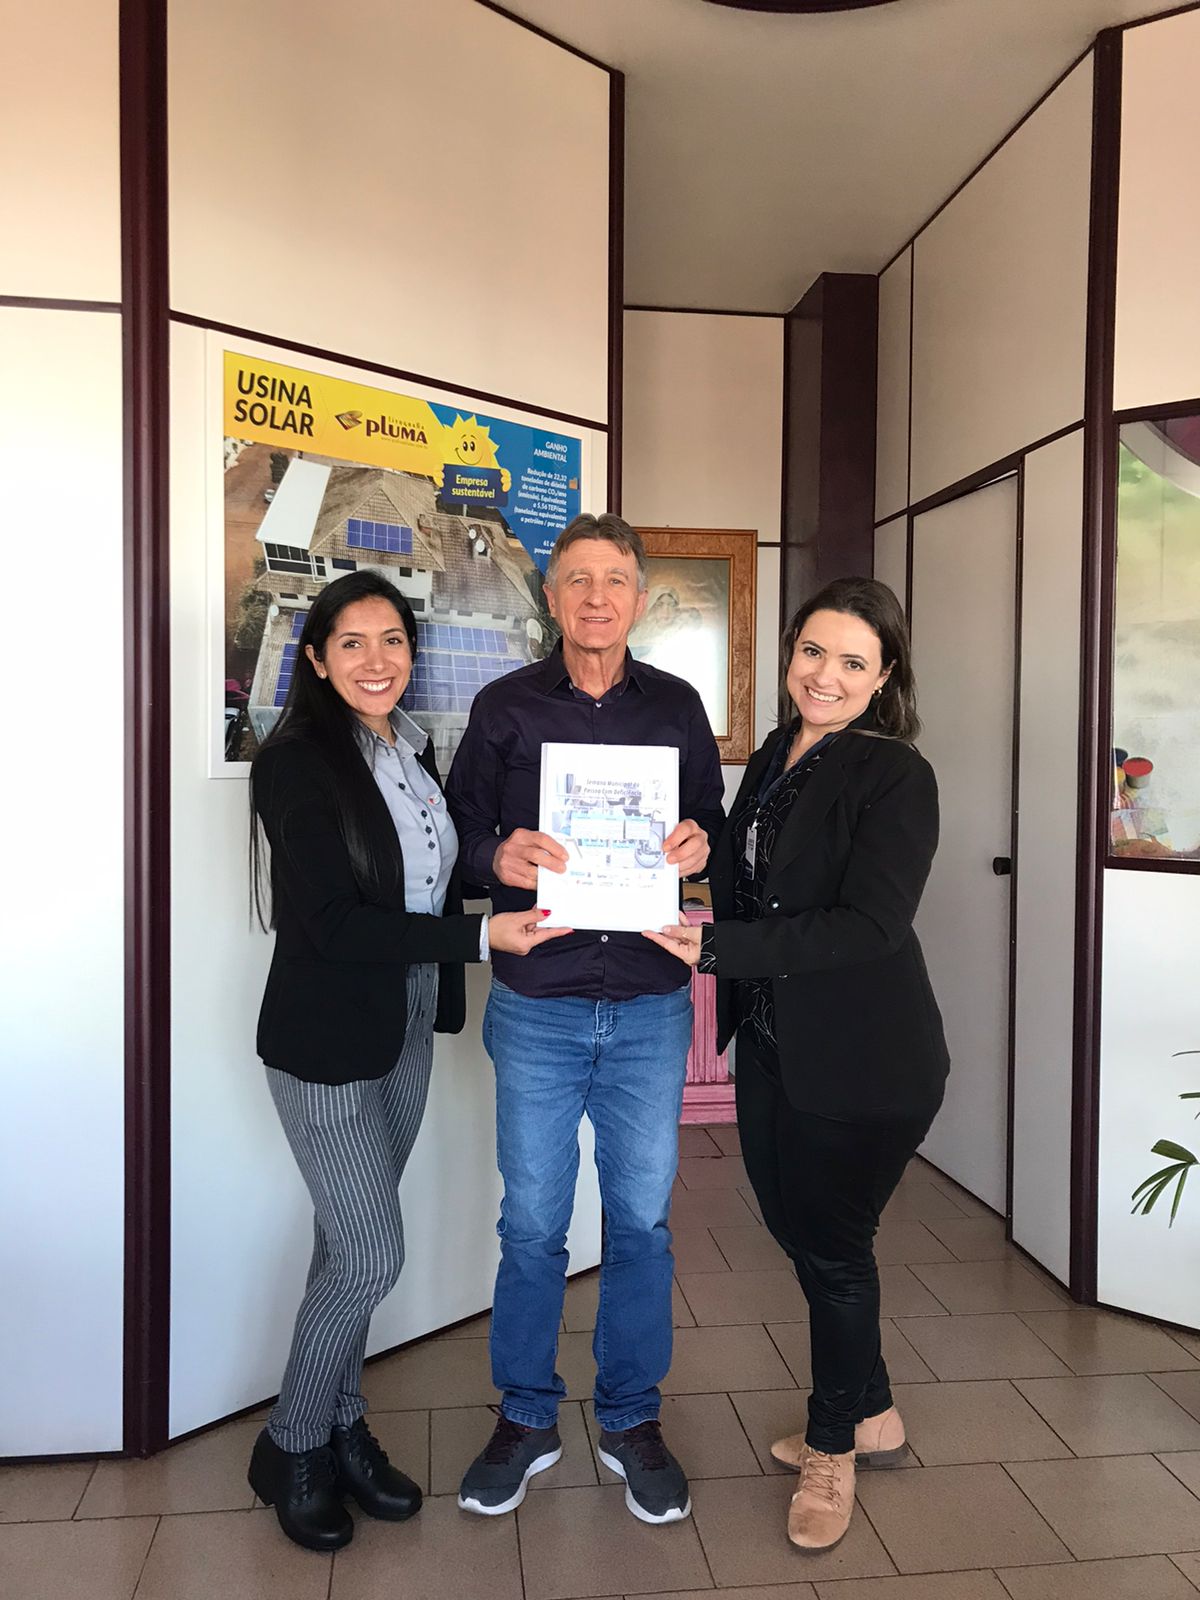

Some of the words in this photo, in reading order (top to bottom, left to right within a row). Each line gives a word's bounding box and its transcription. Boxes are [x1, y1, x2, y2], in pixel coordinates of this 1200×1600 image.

[238, 370, 312, 409] USINA
[234, 399, 314, 437] SOLAR
[545, 441, 568, 453] GANHO
[534, 448, 567, 463] AMBIENTAL
[456, 474, 488, 487] Empresa
[452, 487, 495, 498] sustentável
